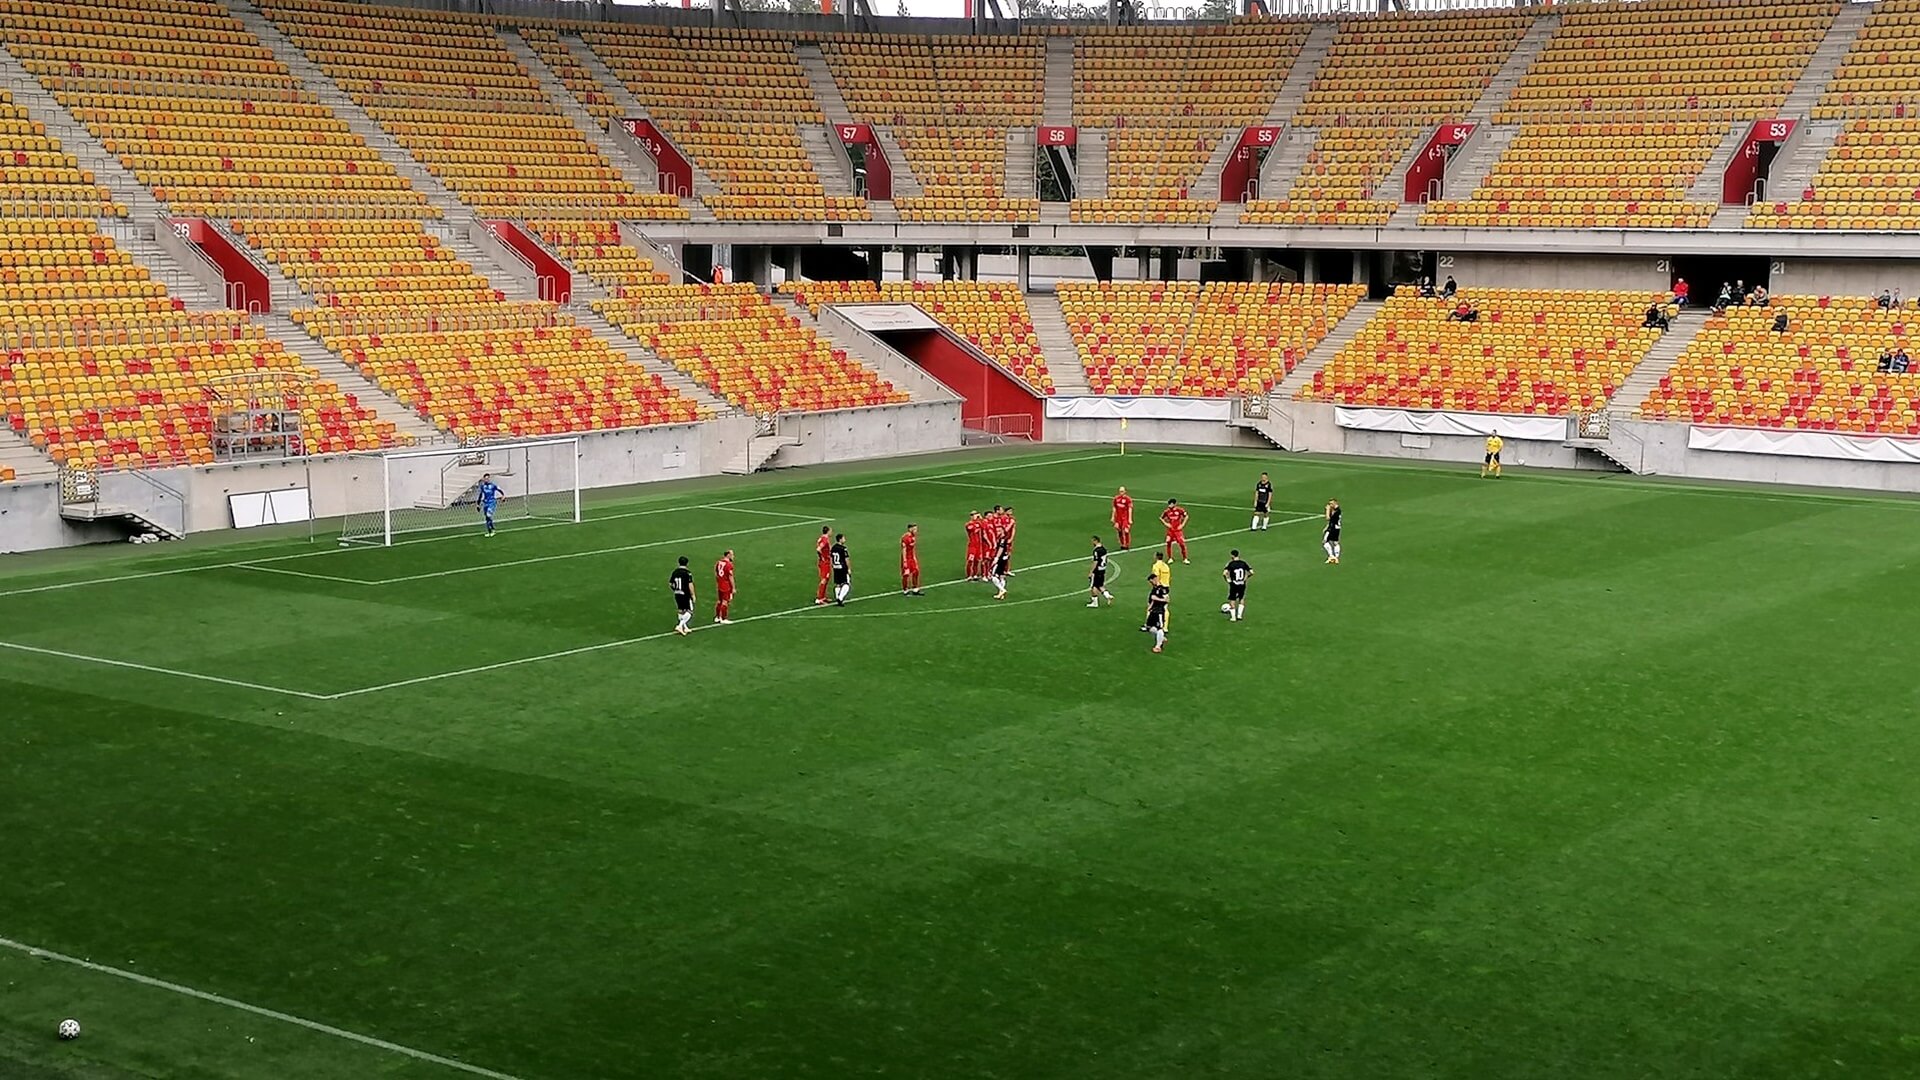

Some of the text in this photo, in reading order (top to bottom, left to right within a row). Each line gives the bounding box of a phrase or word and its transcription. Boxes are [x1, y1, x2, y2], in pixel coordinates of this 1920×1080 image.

[843, 127, 857, 139] 57
[1049, 130, 1065, 142] 56
[1257, 130, 1272, 142] 55
[1769, 123, 1787, 137] 53
[1439, 256, 1455, 268] 22
[1656, 260, 1669, 272] 21
[1771, 262, 1785, 274] 21
[1233, 568, 1244, 580] 10
